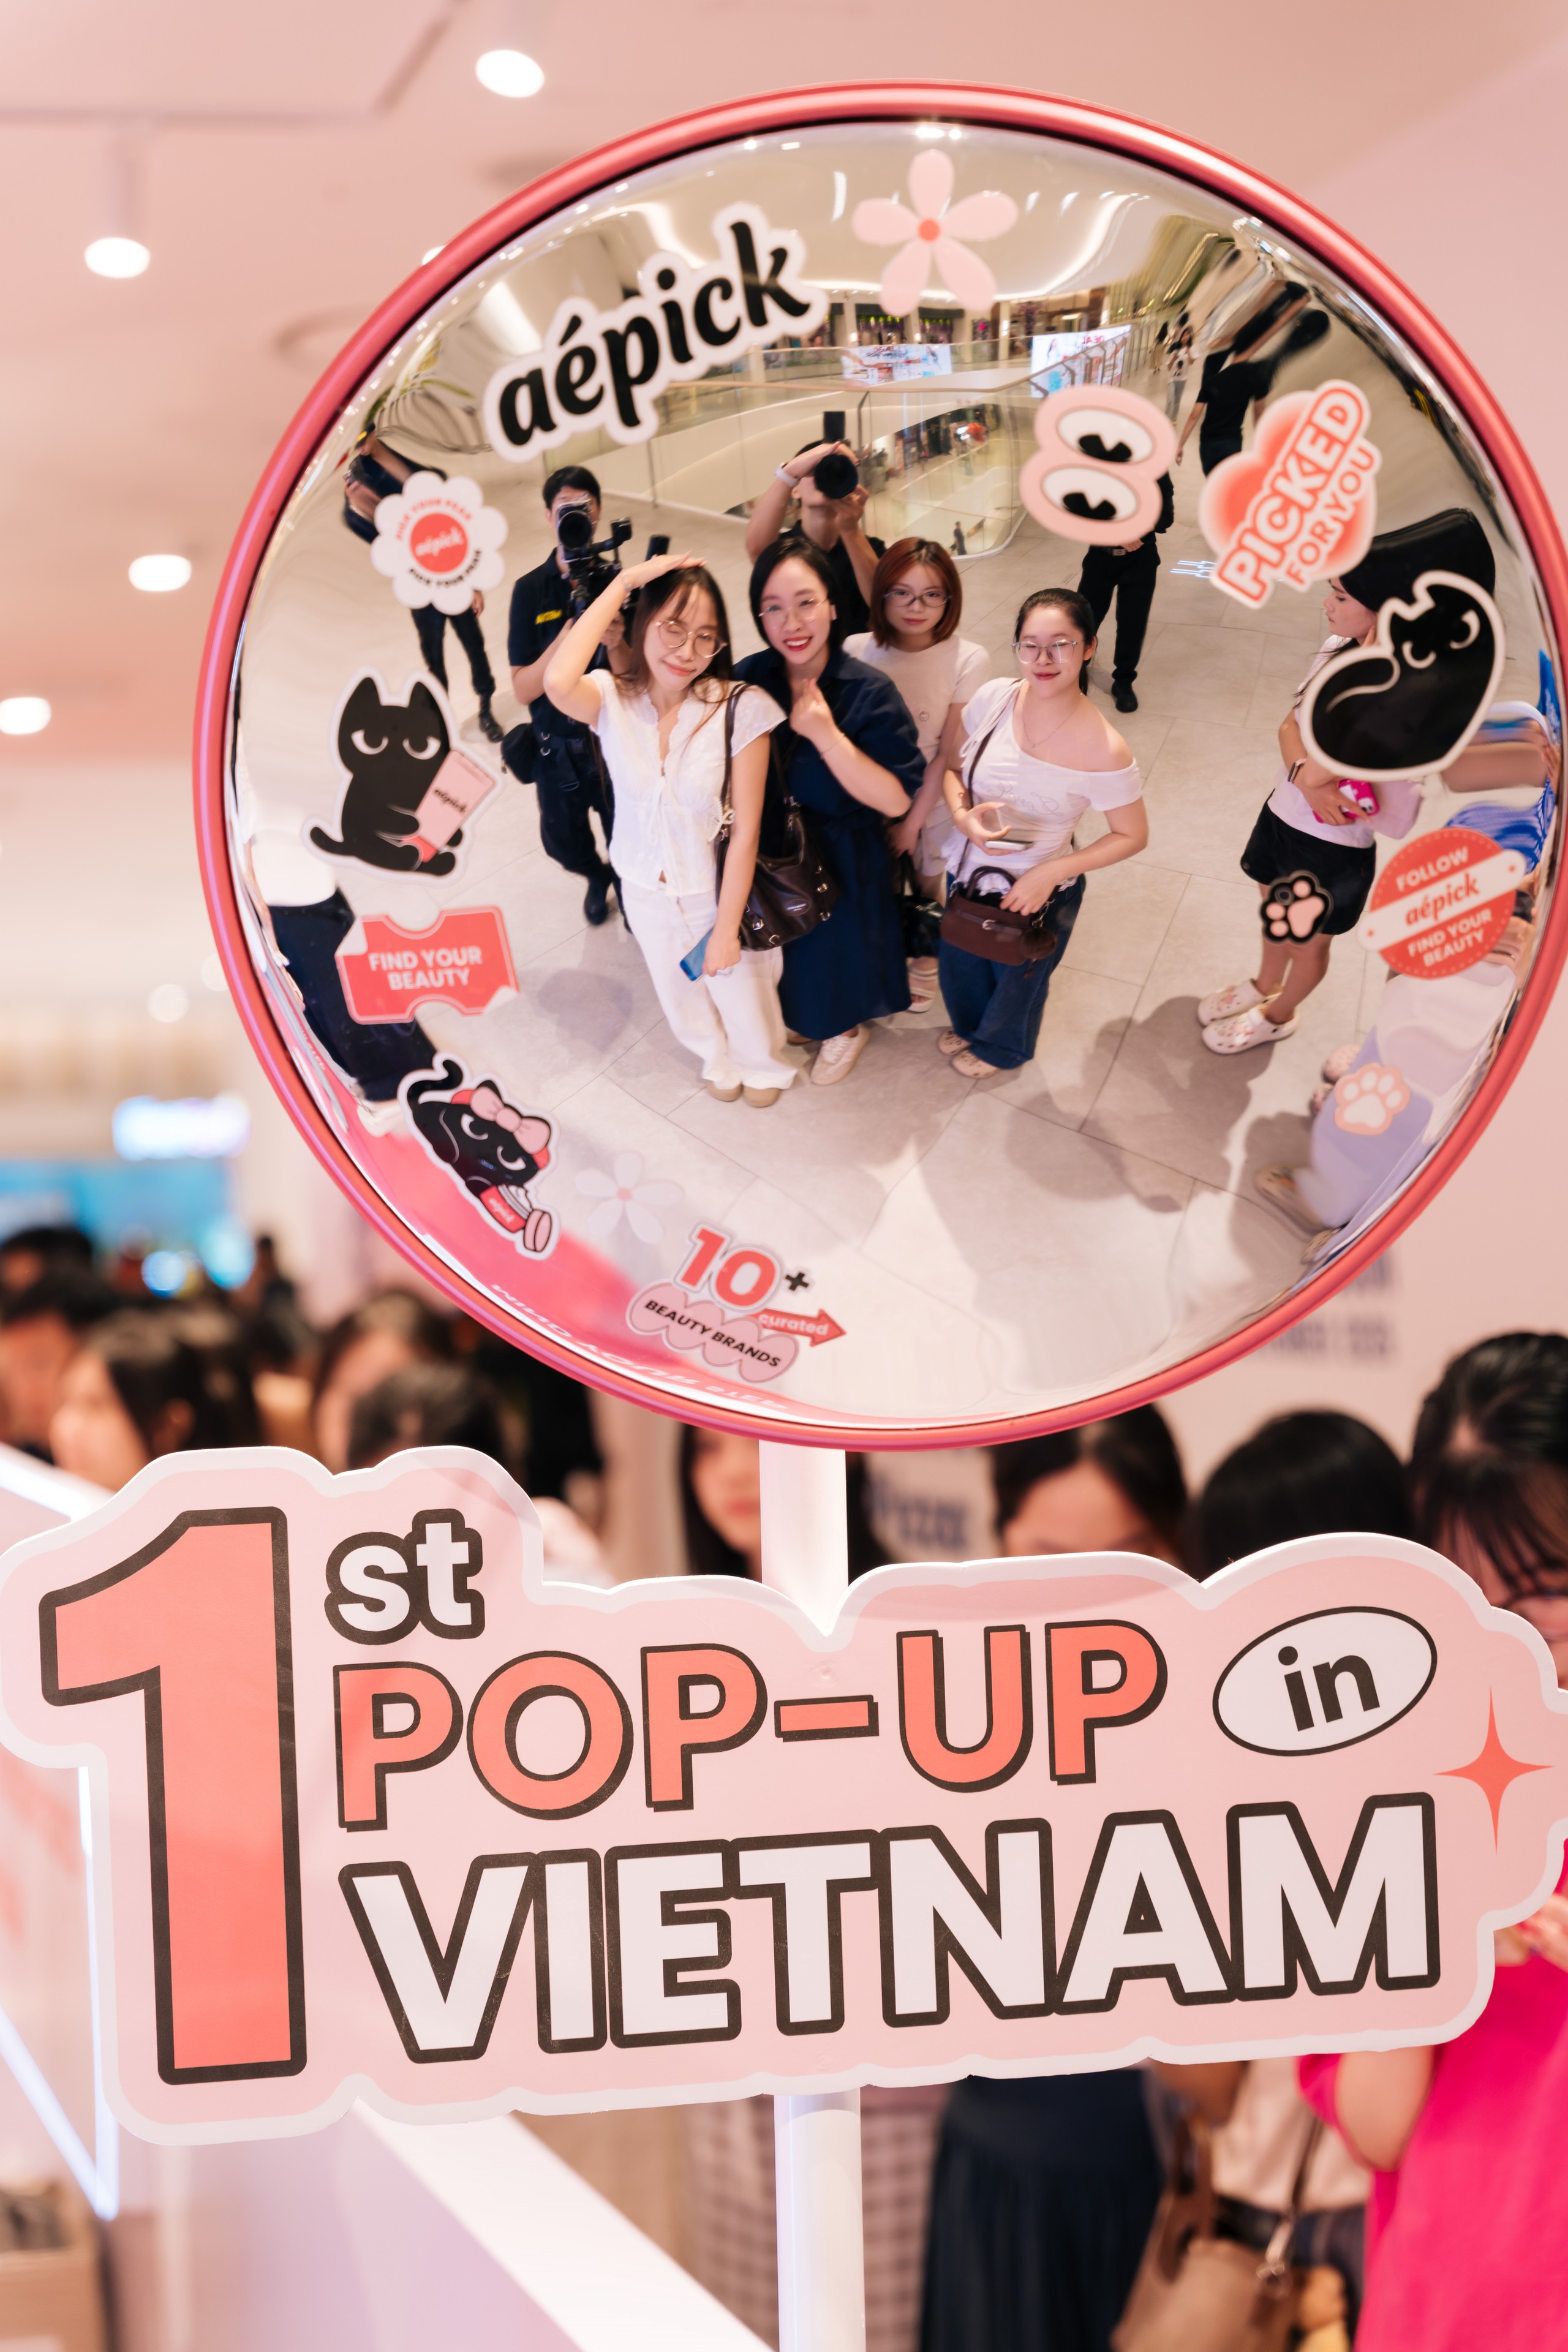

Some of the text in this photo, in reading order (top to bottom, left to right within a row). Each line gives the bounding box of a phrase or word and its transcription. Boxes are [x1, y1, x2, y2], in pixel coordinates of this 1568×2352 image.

[499, 221, 811, 445] aépick
[1219, 388, 1362, 601] PICKED
[1286, 445, 1375, 586] FOR YOU
[415, 526, 465, 557] aépick
[1396, 846, 1469, 891] FOLLOW
[1405, 872, 1480, 926] aépick
[368, 946, 483, 971] FIND YOUR
[1407, 908, 1493, 958] FIND YOUR
[1423, 929, 1485, 967] BEAUTY
[387, 968, 470, 990] BEAUTY
[644, 1299, 782, 1367] BEAUTY BRANDS
[758, 1313, 830, 1336] curated
[333, 1619, 1380, 1832] POP-UP in
[337, 1792, 1441, 2064] VIETNAM
